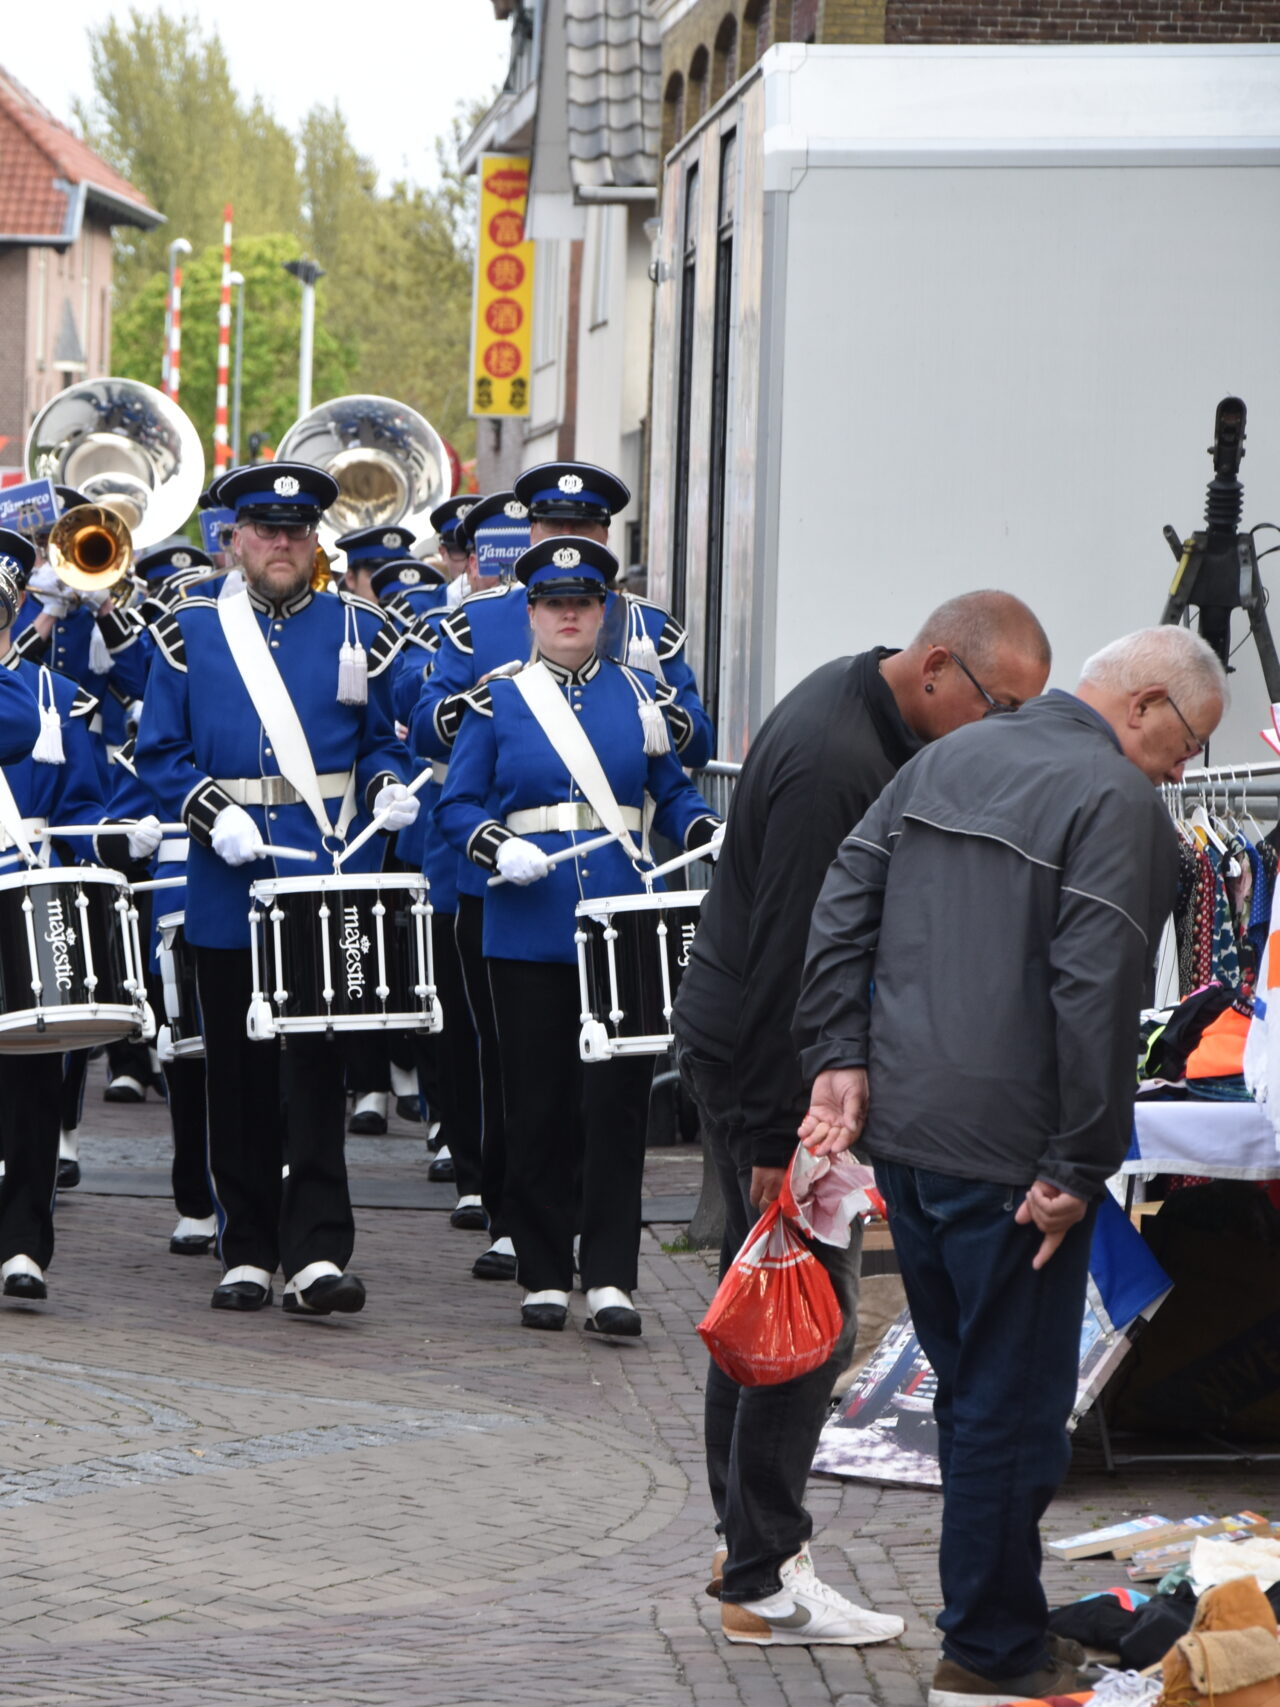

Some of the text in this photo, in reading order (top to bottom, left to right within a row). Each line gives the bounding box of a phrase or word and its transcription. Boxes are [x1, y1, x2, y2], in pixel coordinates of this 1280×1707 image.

[479, 543, 527, 561] Tamarc
[44, 898, 74, 992] majestic
[339, 904, 366, 1001] majestic
